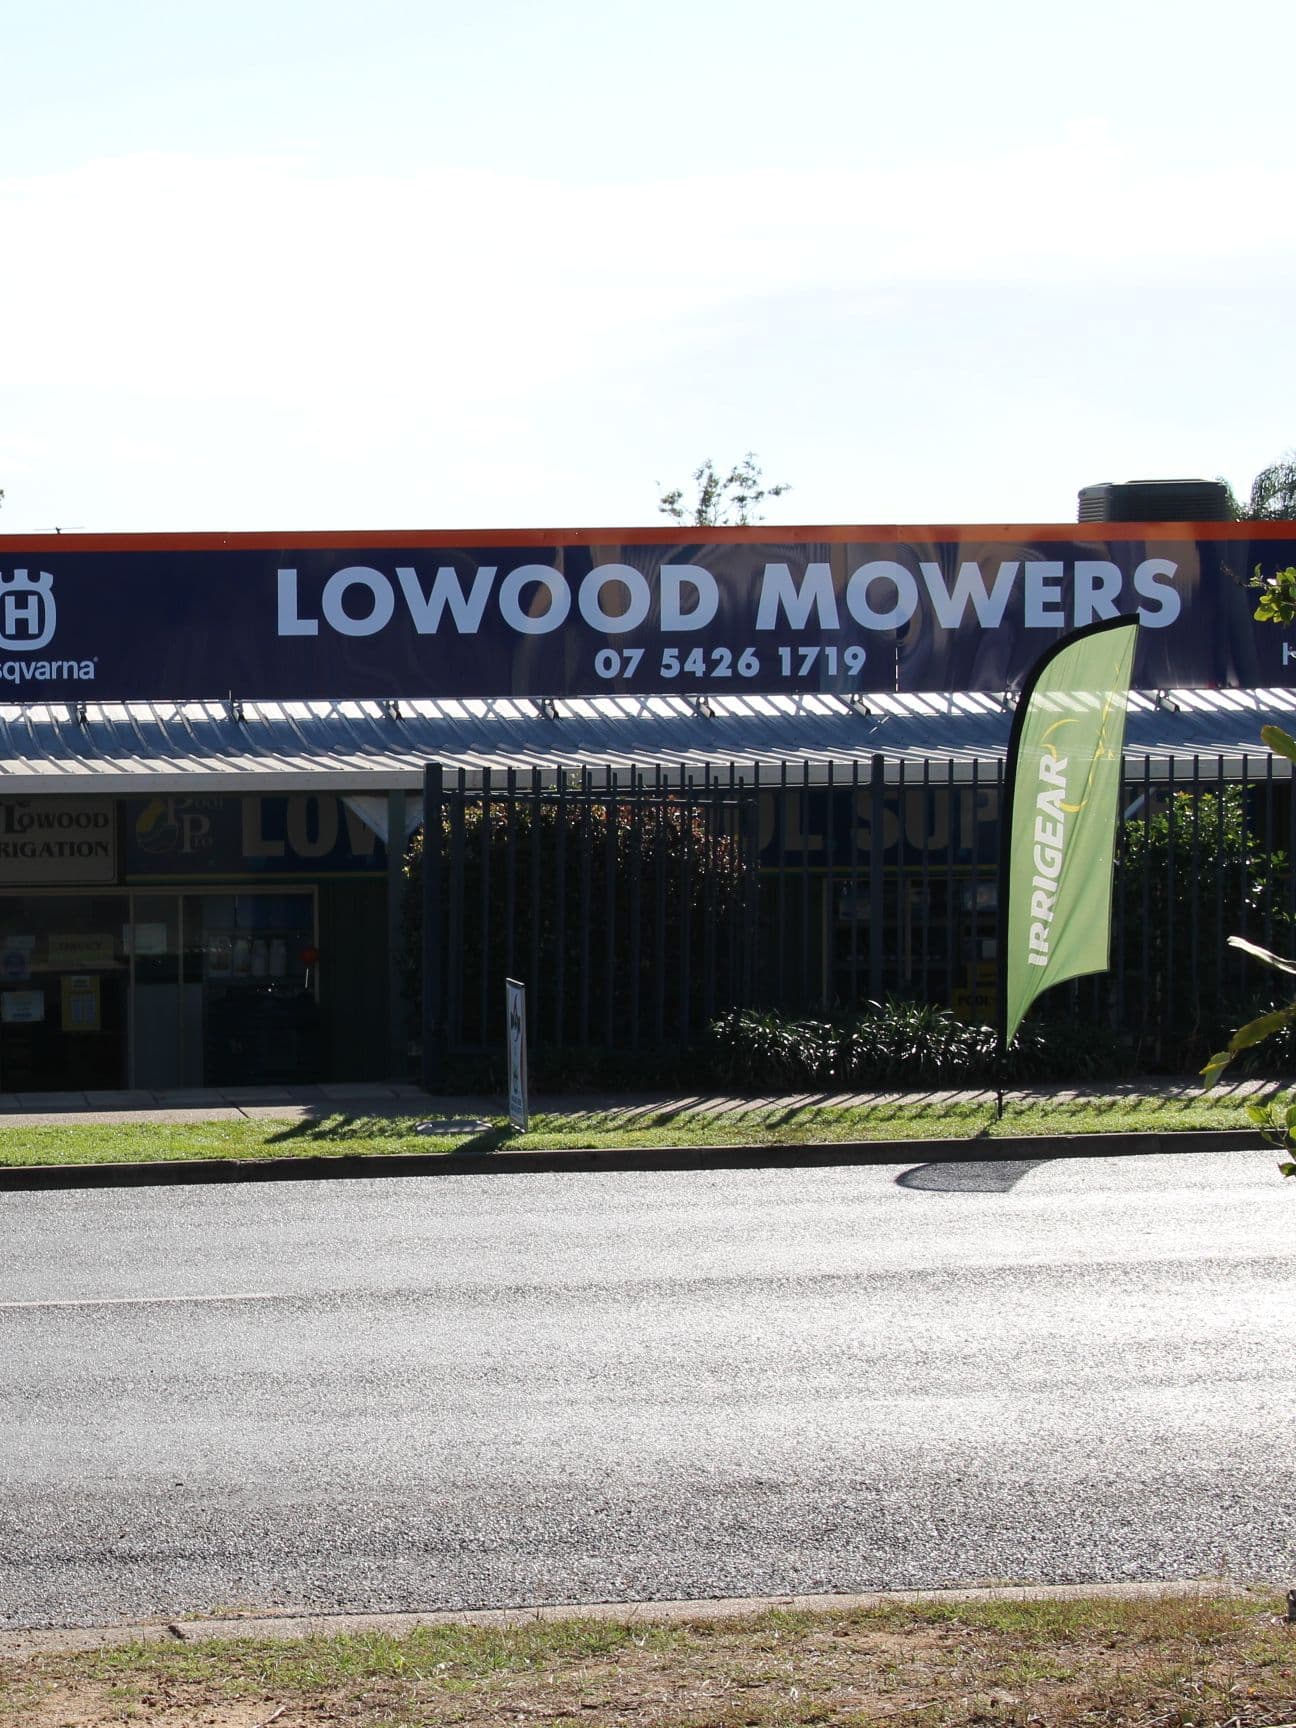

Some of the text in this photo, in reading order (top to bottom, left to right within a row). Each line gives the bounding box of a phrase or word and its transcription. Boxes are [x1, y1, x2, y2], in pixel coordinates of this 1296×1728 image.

[277, 558, 1181, 637] LOWOOD MOWERS
[594, 645, 867, 678] 07 5426 1719
[1028, 753, 1069, 967] IRRIGEAR
